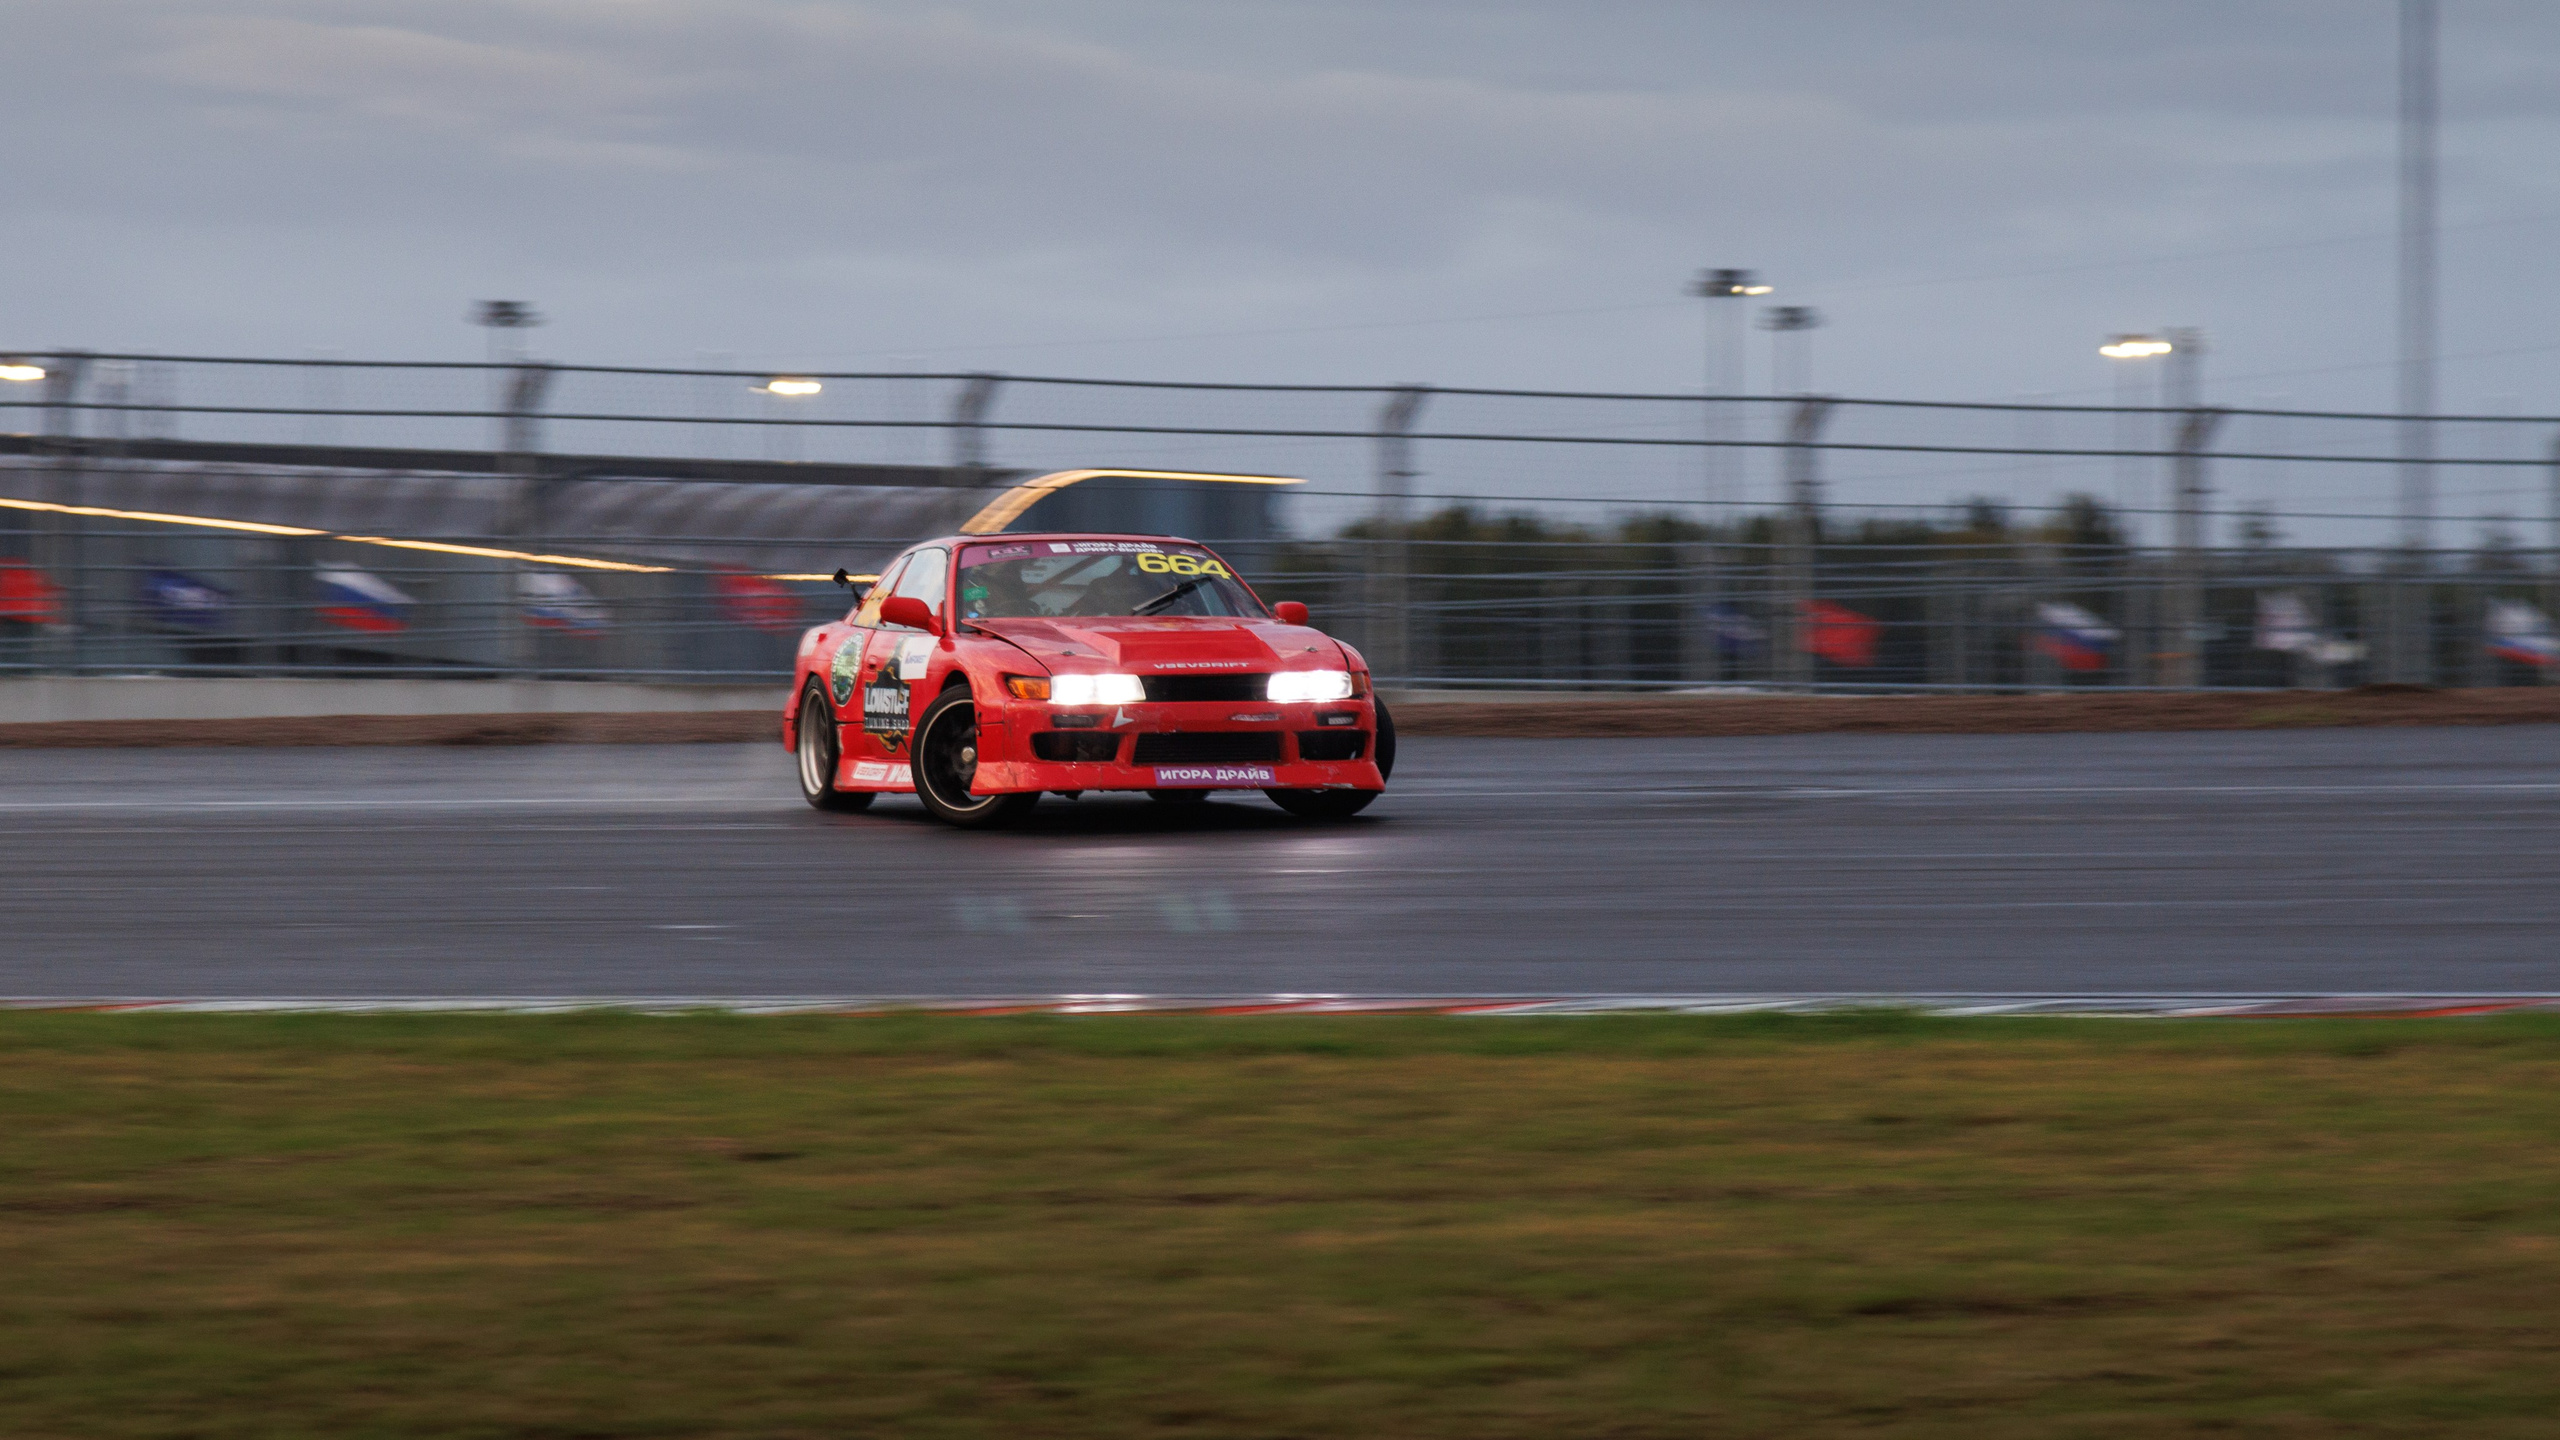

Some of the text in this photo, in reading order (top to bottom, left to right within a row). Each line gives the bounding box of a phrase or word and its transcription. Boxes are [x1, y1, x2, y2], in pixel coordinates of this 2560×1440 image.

[1137, 553, 1231, 580] 664
[1160, 767, 1270, 781] ИГОРА ДРАЙВ
